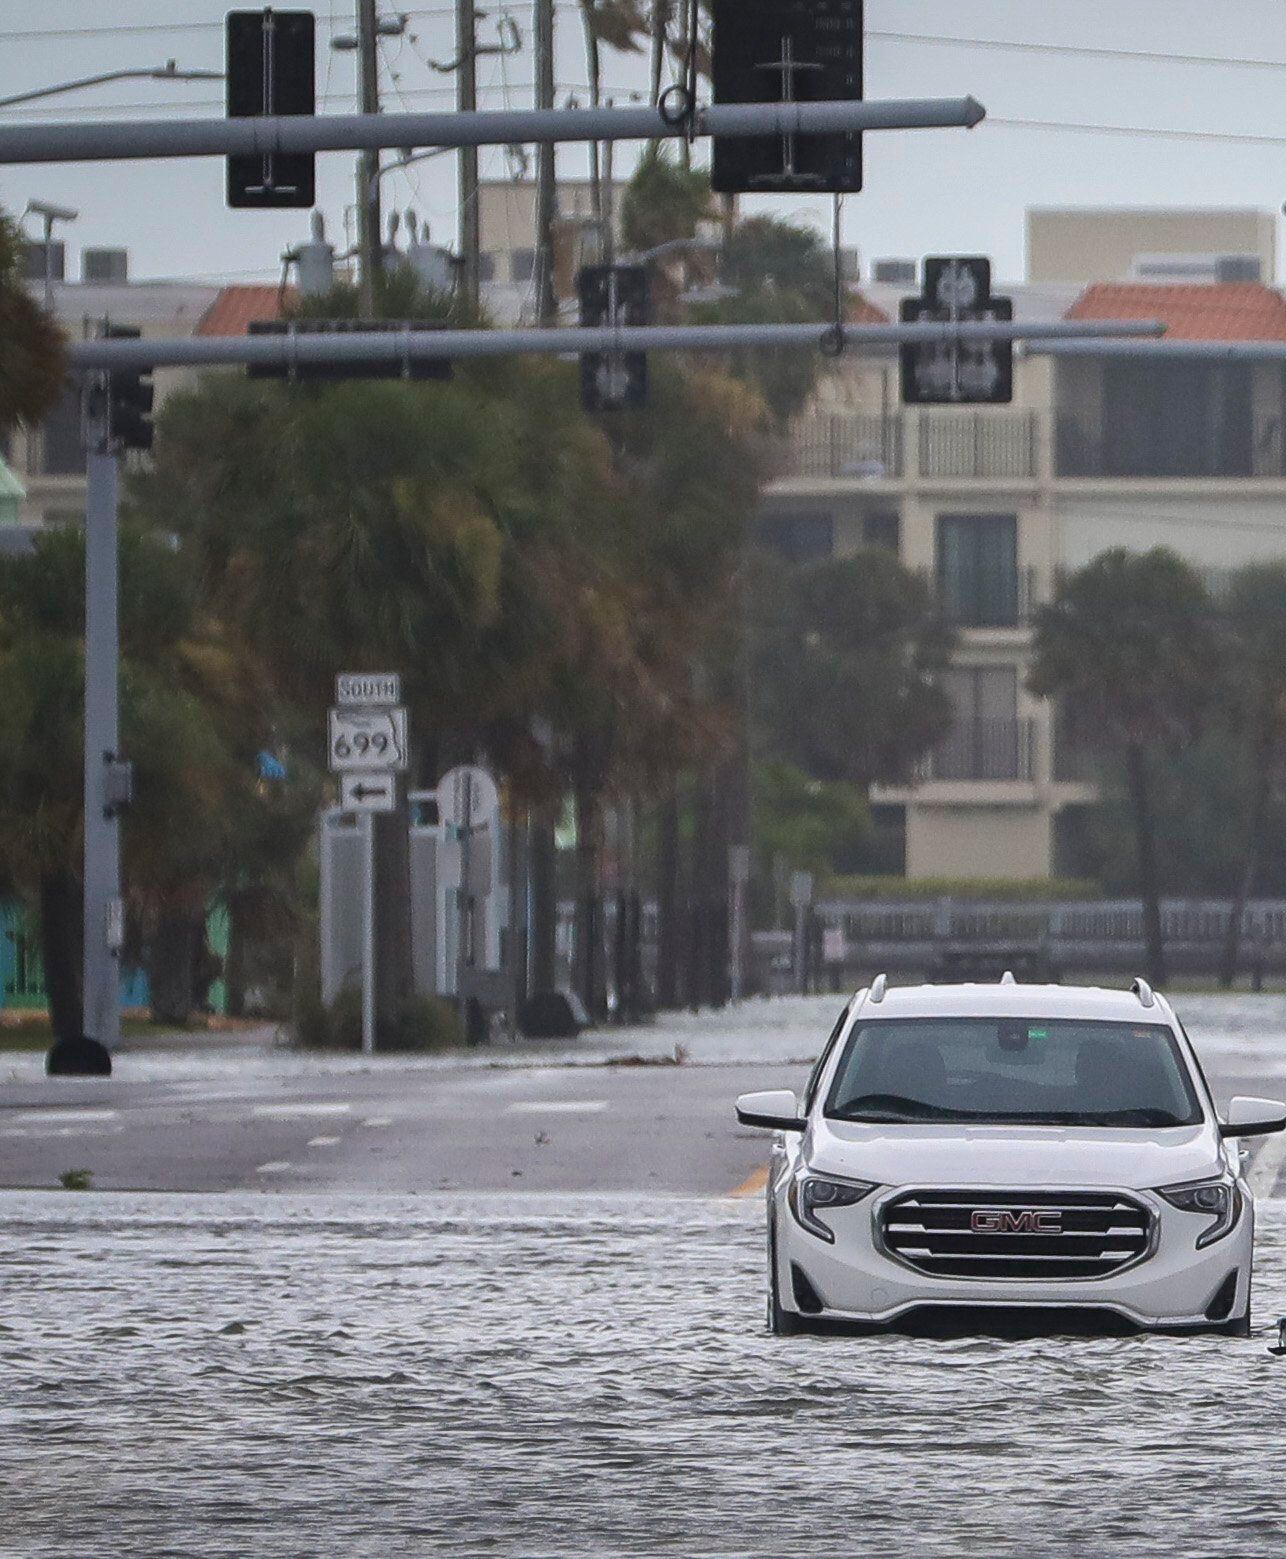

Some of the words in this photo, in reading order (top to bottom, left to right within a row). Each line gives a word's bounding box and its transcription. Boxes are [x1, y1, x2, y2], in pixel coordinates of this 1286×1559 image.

[340, 682, 395, 696] SOUTH
[335, 732, 388, 758] 699
[971, 1211, 1061, 1232] GMC
